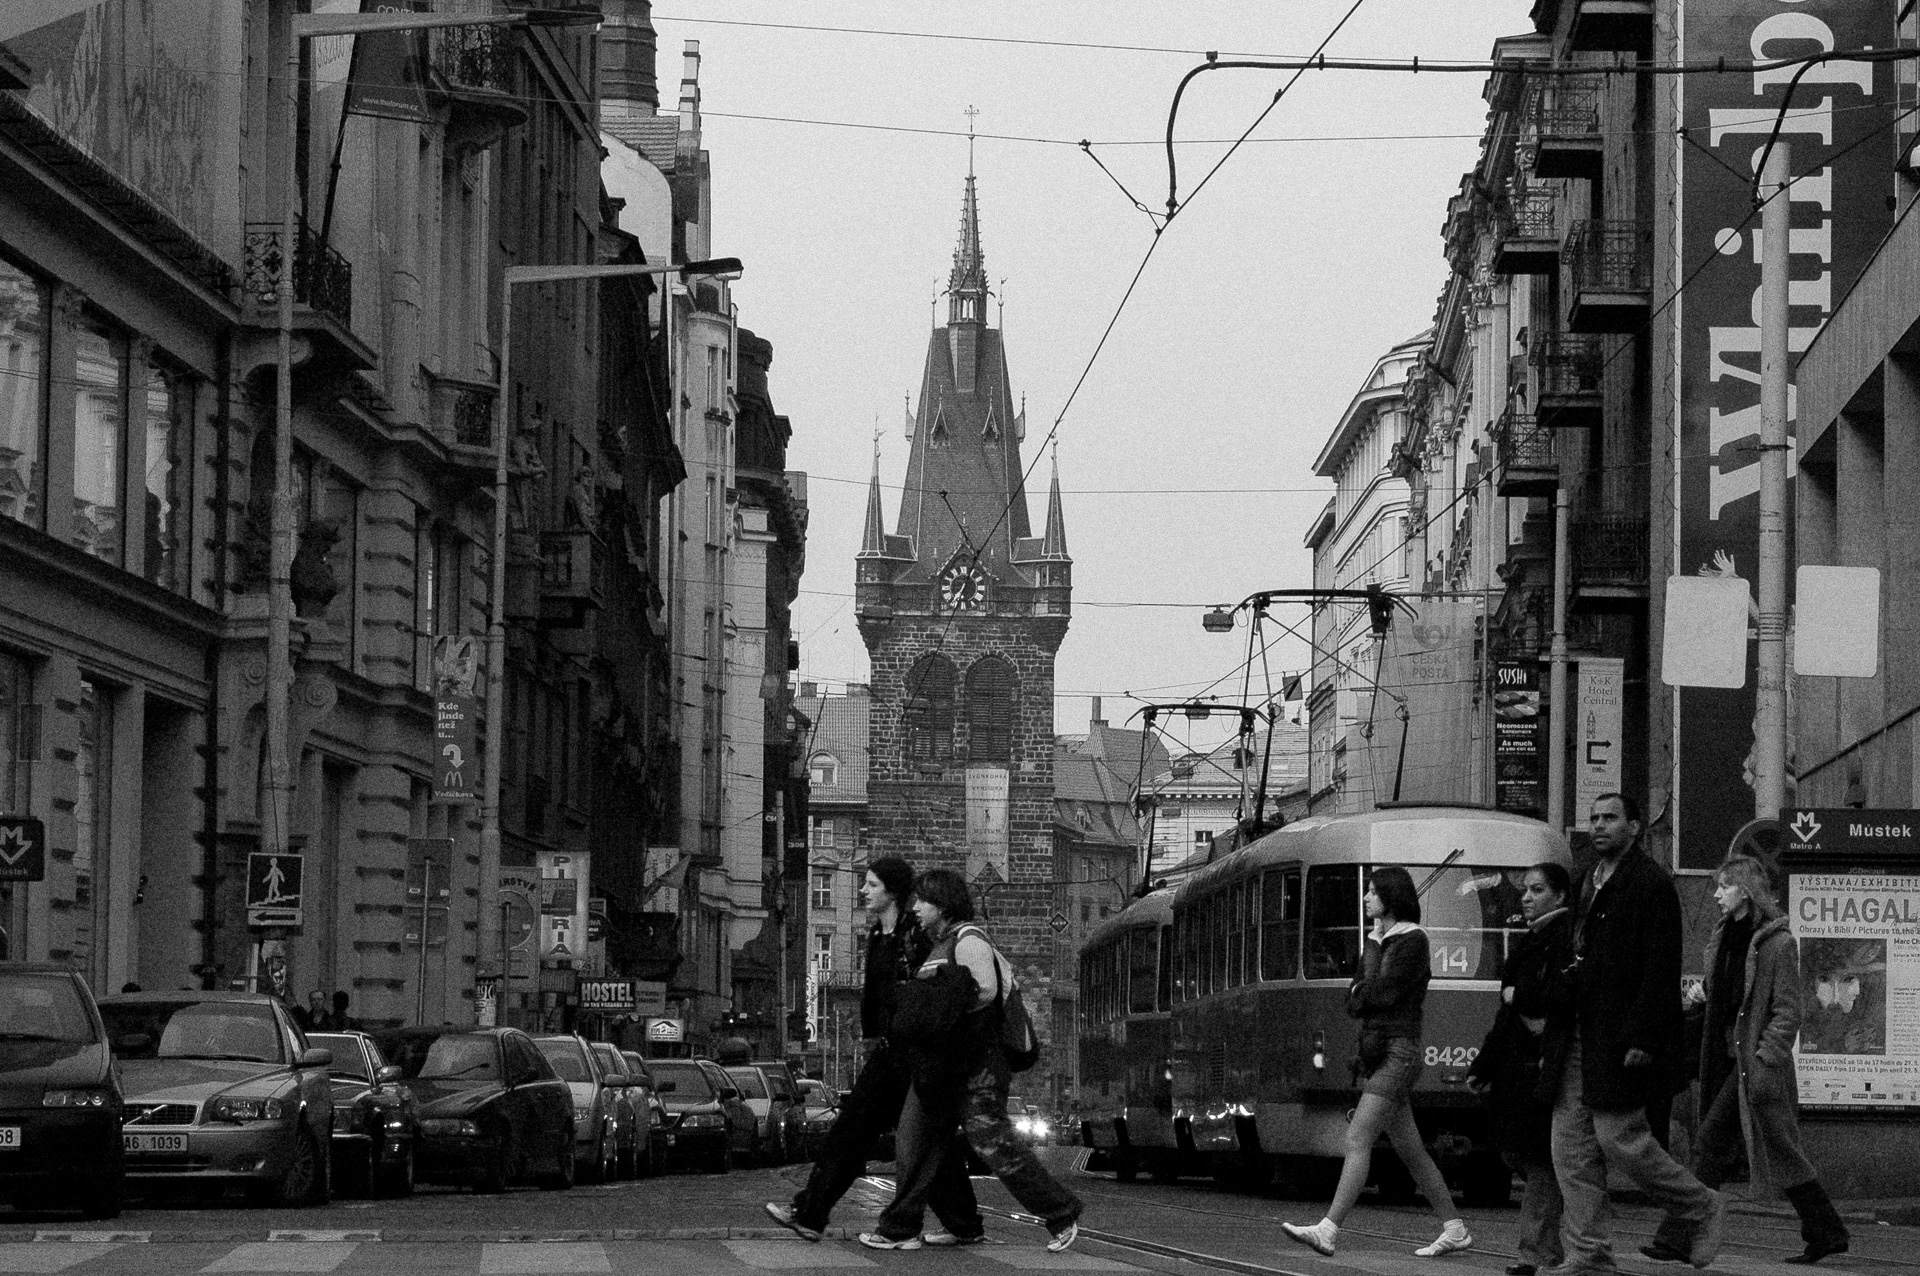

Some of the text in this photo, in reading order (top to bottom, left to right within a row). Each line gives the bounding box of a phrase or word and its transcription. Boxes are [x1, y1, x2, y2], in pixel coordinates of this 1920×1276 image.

[1709, 0, 1873, 521] Whirlp
[1588, 686, 1613, 695] Hotel
[438, 702, 459, 710] Kde
[1583, 695, 1617, 705] Central
[438, 711, 464, 721] jinde
[438, 720, 456, 729] než
[1849, 824, 1912, 838] Můstek
[1799, 924, 1825, 935] Obrazy
[1858, 926, 1890, 934] Pictures
[1434, 946, 1468, 972] 14
[581, 982, 634, 1001] HOSTEL
[1424, 1046, 1480, 1067] 8429
[151, 1136, 182, 1150] 1039
